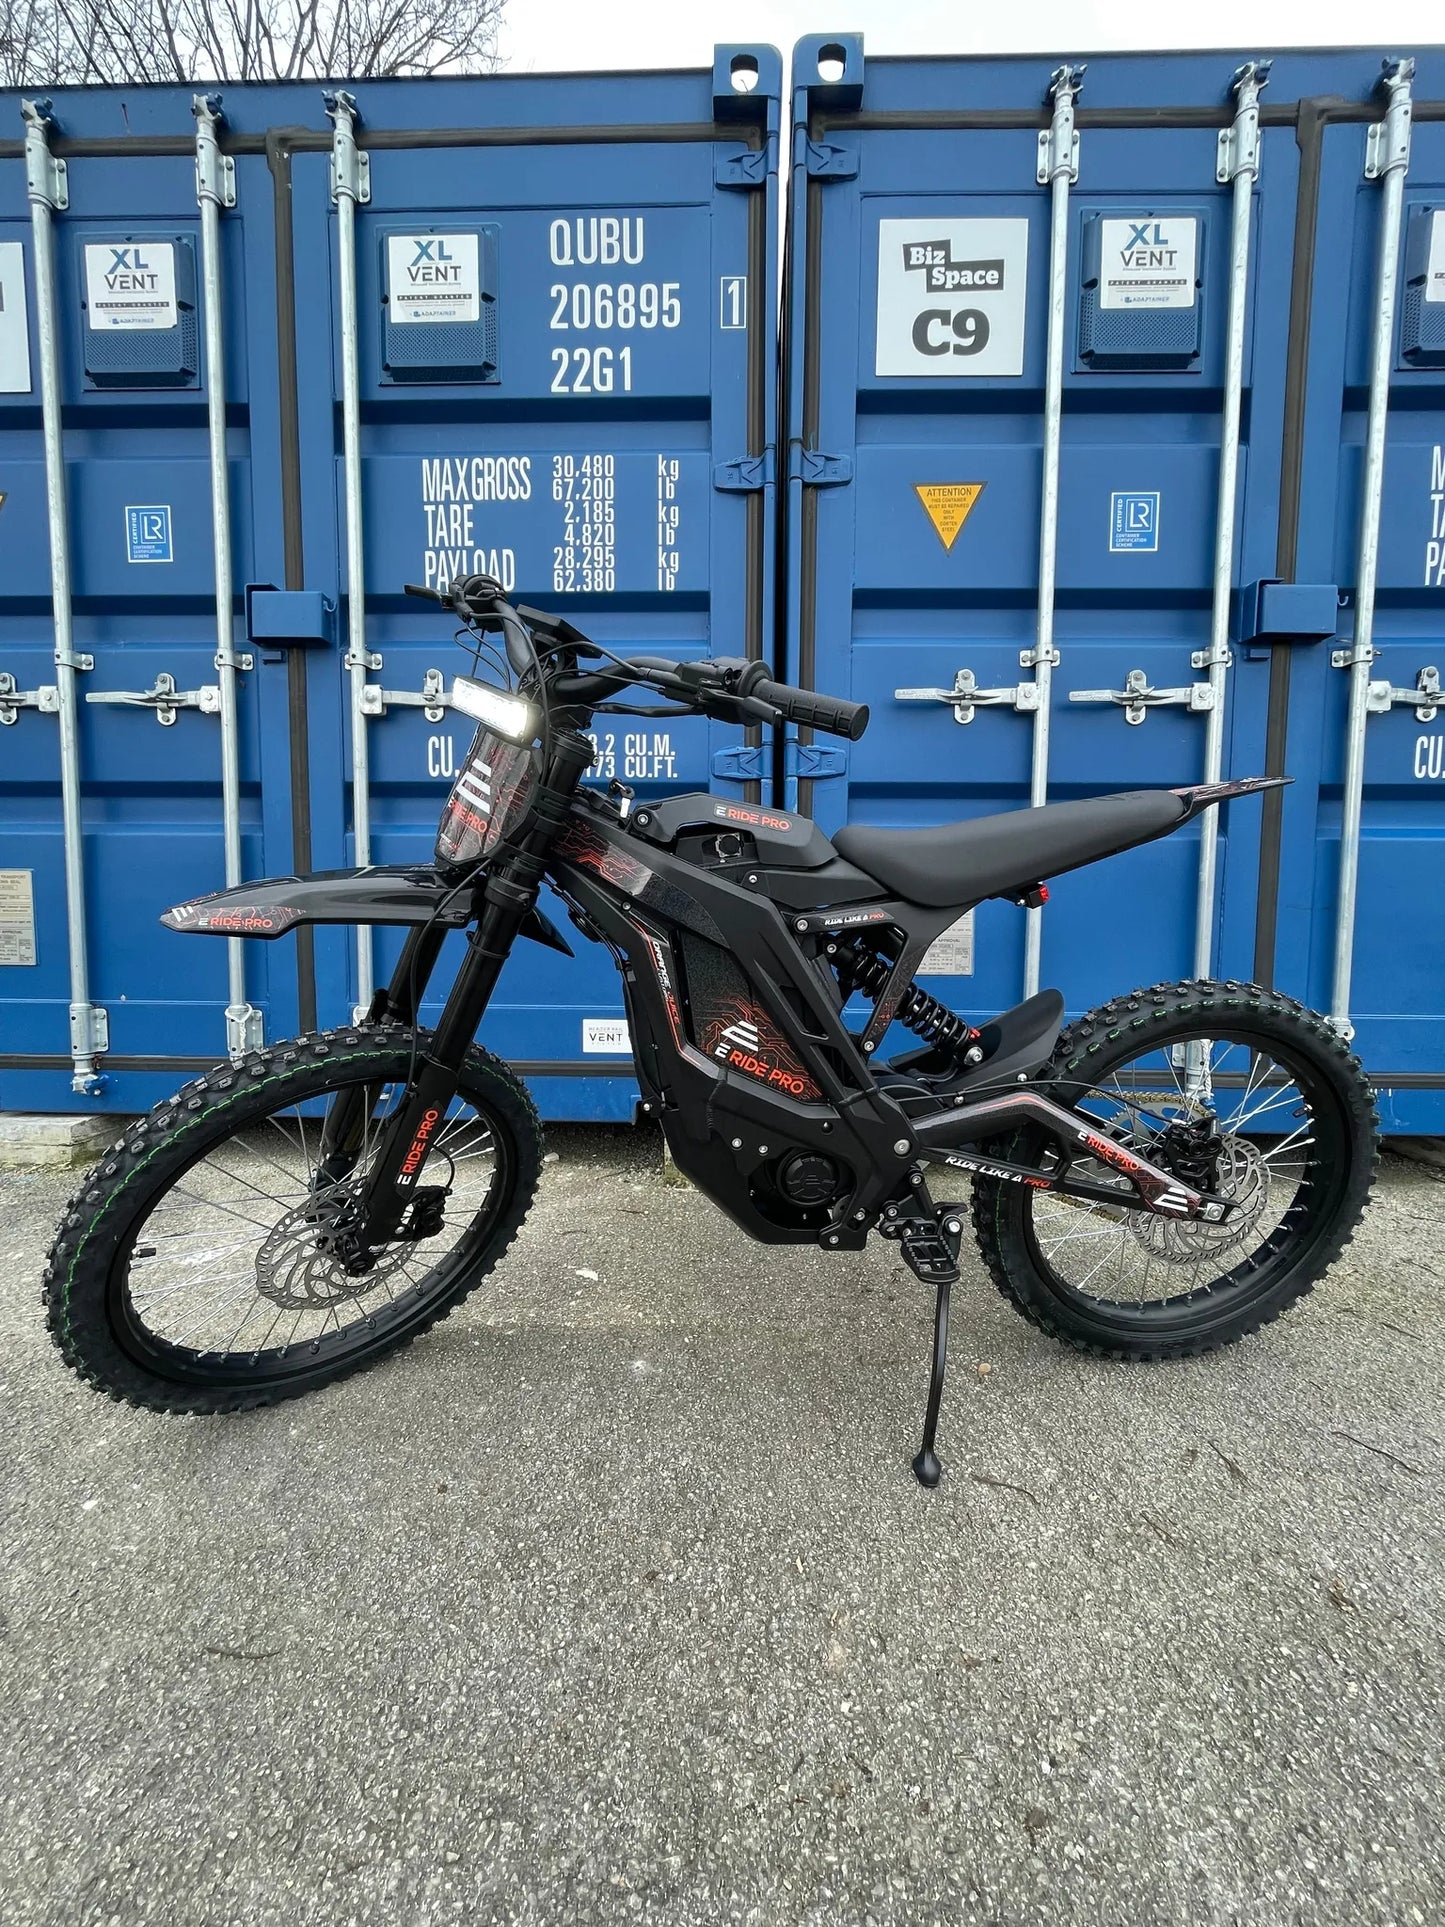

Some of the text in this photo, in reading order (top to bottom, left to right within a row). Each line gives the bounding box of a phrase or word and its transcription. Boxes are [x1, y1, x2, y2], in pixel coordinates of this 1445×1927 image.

[550, 217, 644, 266] QUBU
[1124, 223, 1169, 251] XL
[107, 248, 149, 275] XL
[409, 239, 453, 267] XL
[909, 245, 946, 265] Biz
[1120, 250, 1178, 267] VENT
[104, 274, 158, 290] VENT
[407, 265, 462, 282] VENT
[931, 266, 1000, 289] Space
[550, 280, 740, 329] 206895 1
[911, 308, 991, 356] C9
[550, 346, 632, 393] 22G1
[471, 456, 532, 501] GROSS
[552, 455, 615, 478] 30,480
[658, 454, 680, 481] kg
[552, 476, 675, 501] 67,200 lb
[926, 487, 972, 497] ATTENTION
[423, 500, 680, 548] TARE 2,185 kg
[564, 522, 675, 546] 4,820 lb
[553, 546, 615, 569] 28,295
[658, 545, 680, 573] kg
[553, 568, 675, 592] 62,380 lb
[428, 735, 460, 778] CU.
[624, 734, 676, 756] CU.M.
[624, 756, 678, 778] CU.FT.
[728, 808, 760, 825] RIDE
[761, 816, 790, 830] PRO
[210, 917, 242, 927] RIDE
[244, 918, 274, 928] PRO
[589, 1032, 623, 1042] VENT
[714, 1042, 805, 1094] E RIDE PRO
[396, 1109, 439, 1185] E RIDE PRO
[1087, 1133, 1114, 1157] RIDE
[1114, 1151, 1140, 1170] PRO
[944, 1155, 1051, 1188] RIDE LIKE A PRO
